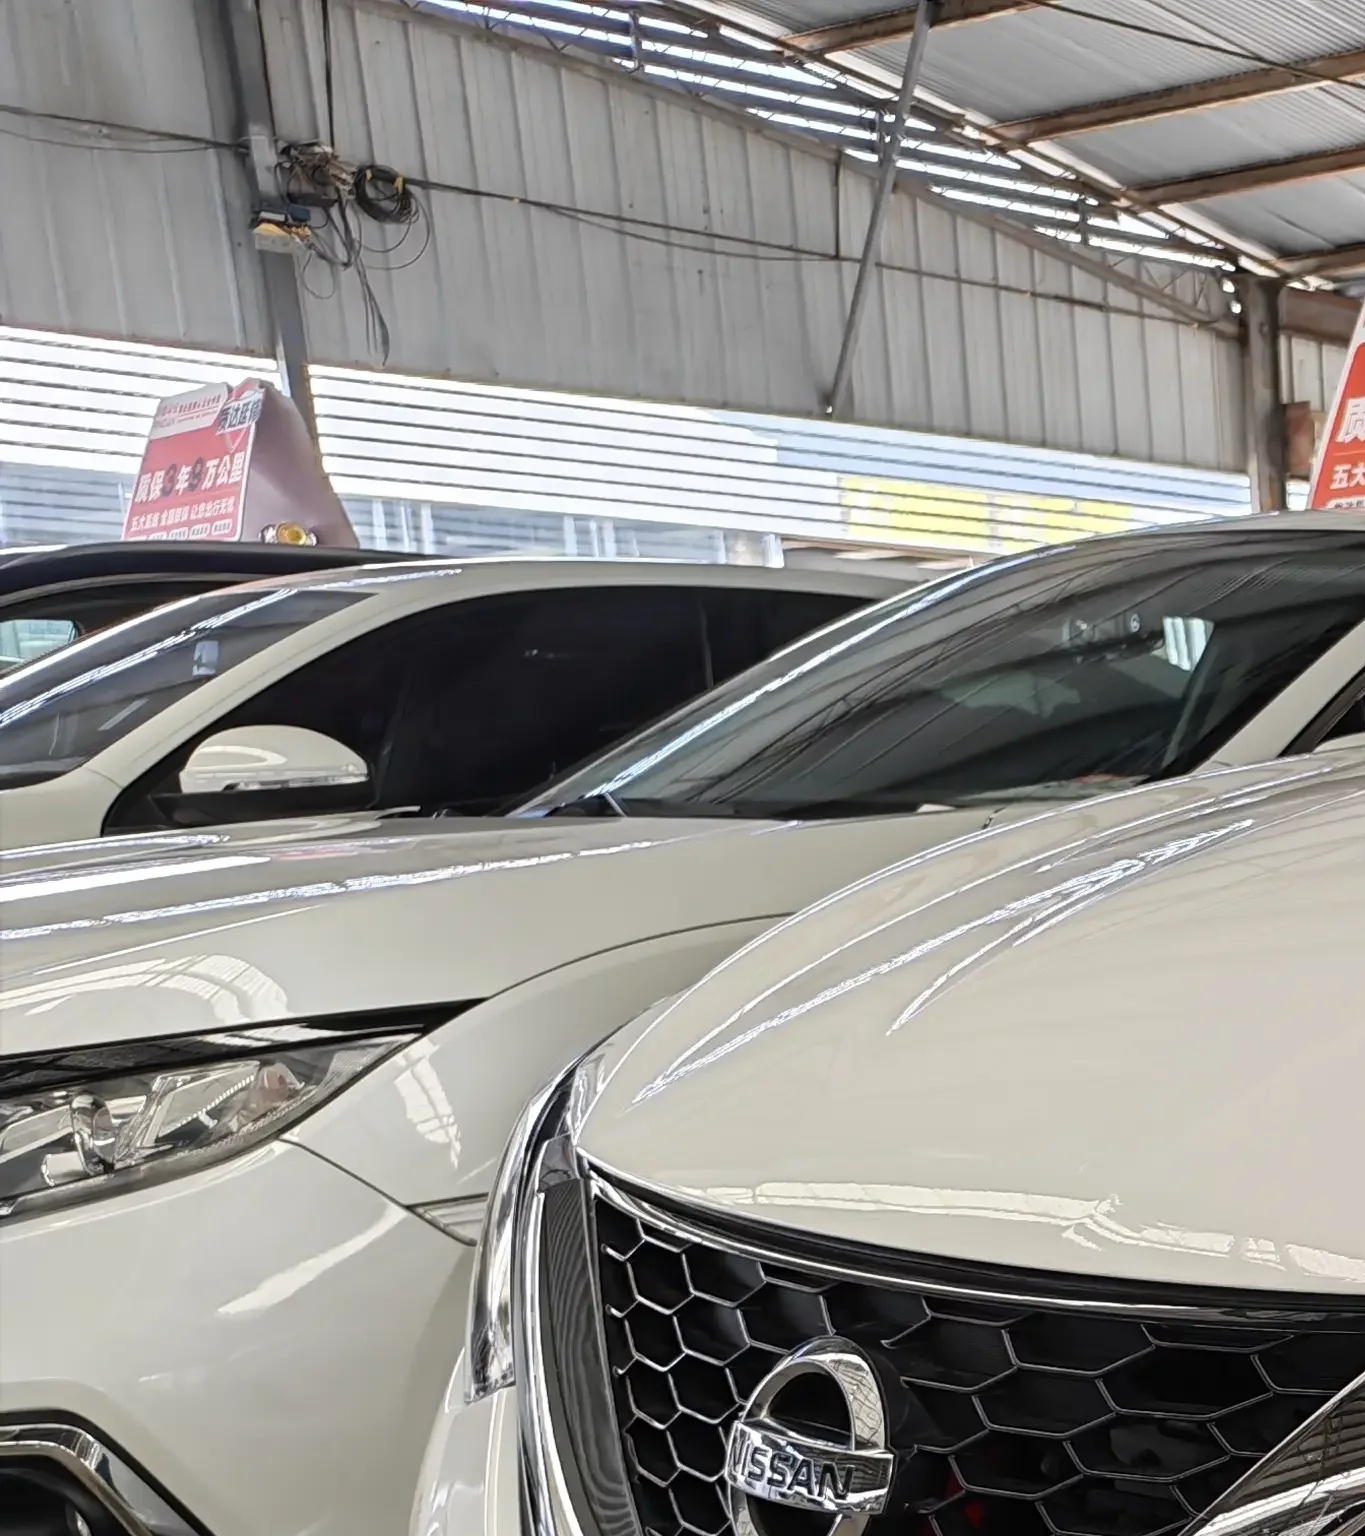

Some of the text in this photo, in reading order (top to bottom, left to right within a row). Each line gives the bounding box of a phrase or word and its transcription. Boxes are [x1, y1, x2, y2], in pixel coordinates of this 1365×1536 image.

[134, 451, 245, 503] 质保3年9万公里
